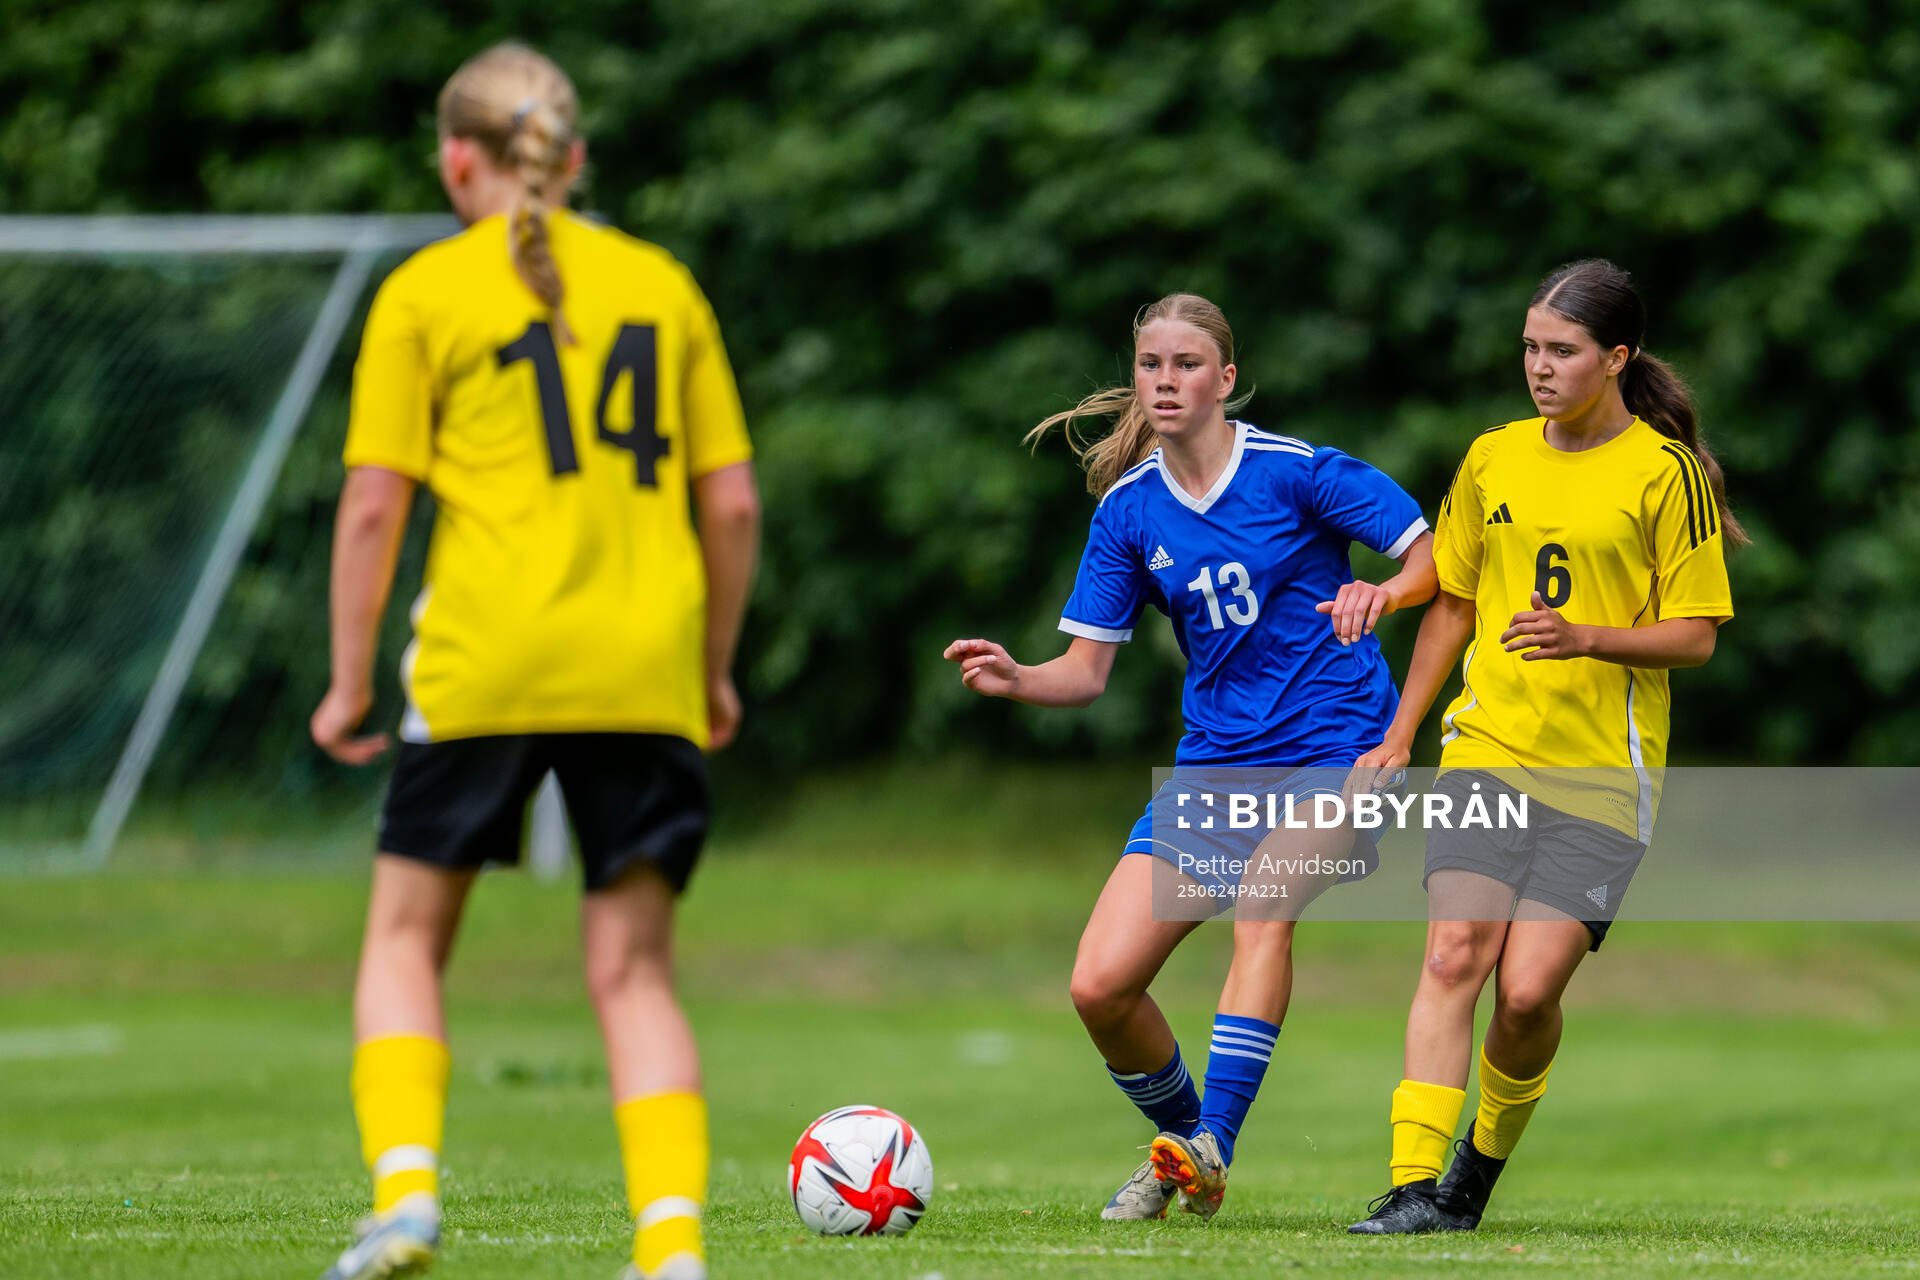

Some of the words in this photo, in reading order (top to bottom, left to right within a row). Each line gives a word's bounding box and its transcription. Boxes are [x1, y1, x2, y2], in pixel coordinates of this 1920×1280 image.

[495, 321, 672, 487] 14
[1148, 557, 1175, 572] adidas
[1187, 561, 1259, 631] 13
[1534, 542, 1572, 609] 6
